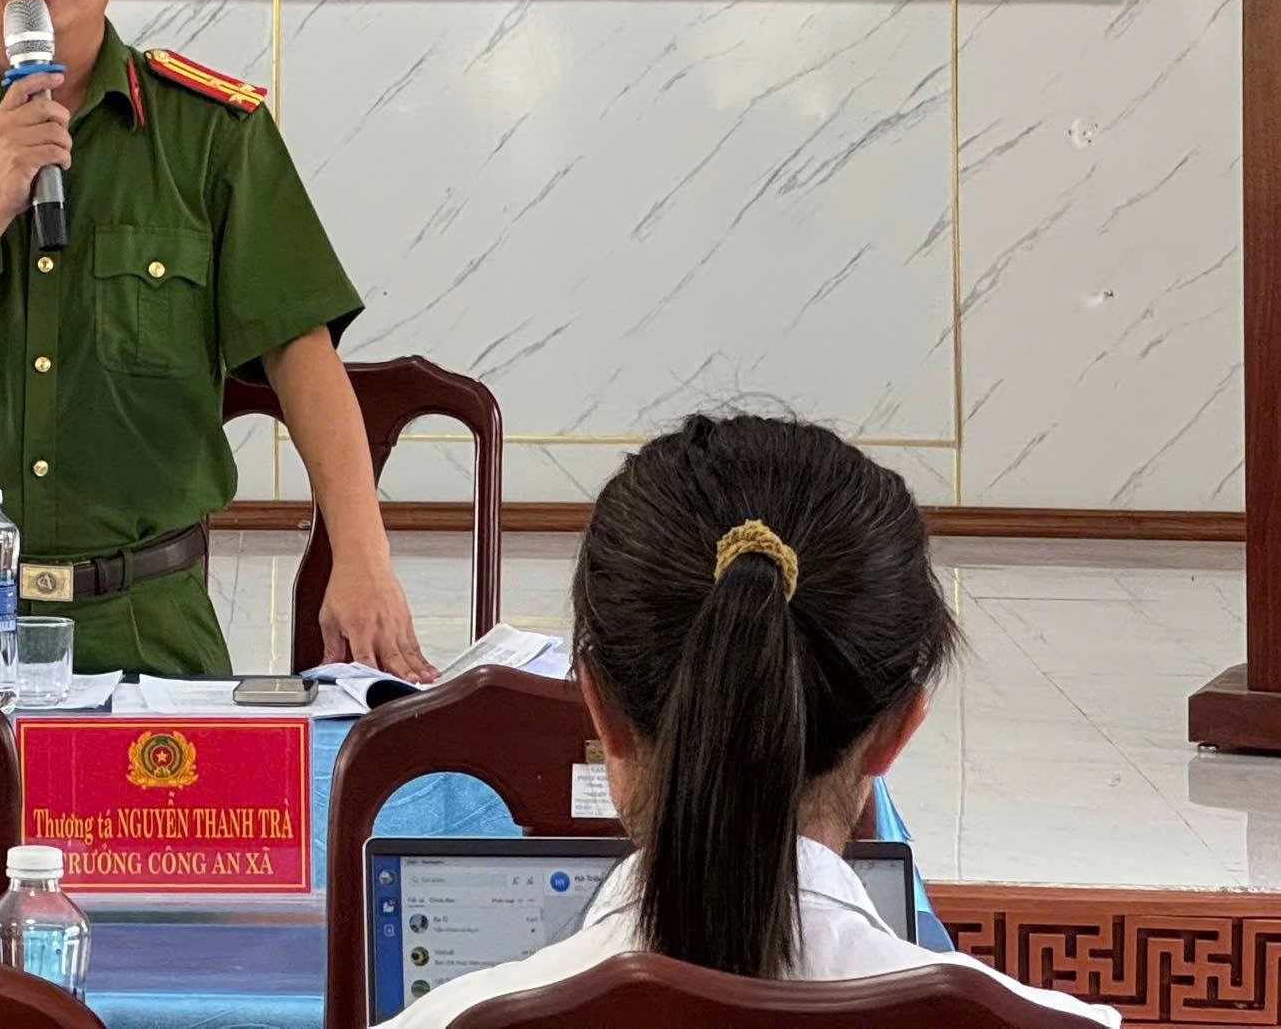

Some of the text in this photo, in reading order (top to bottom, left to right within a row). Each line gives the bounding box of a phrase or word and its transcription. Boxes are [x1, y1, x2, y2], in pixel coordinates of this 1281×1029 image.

[33, 791, 294, 846] Thượng tá NGUYỄN THANH TRÀ
[63, 843, 274, 875] RƯỞNG CÔNG AN XÃ
